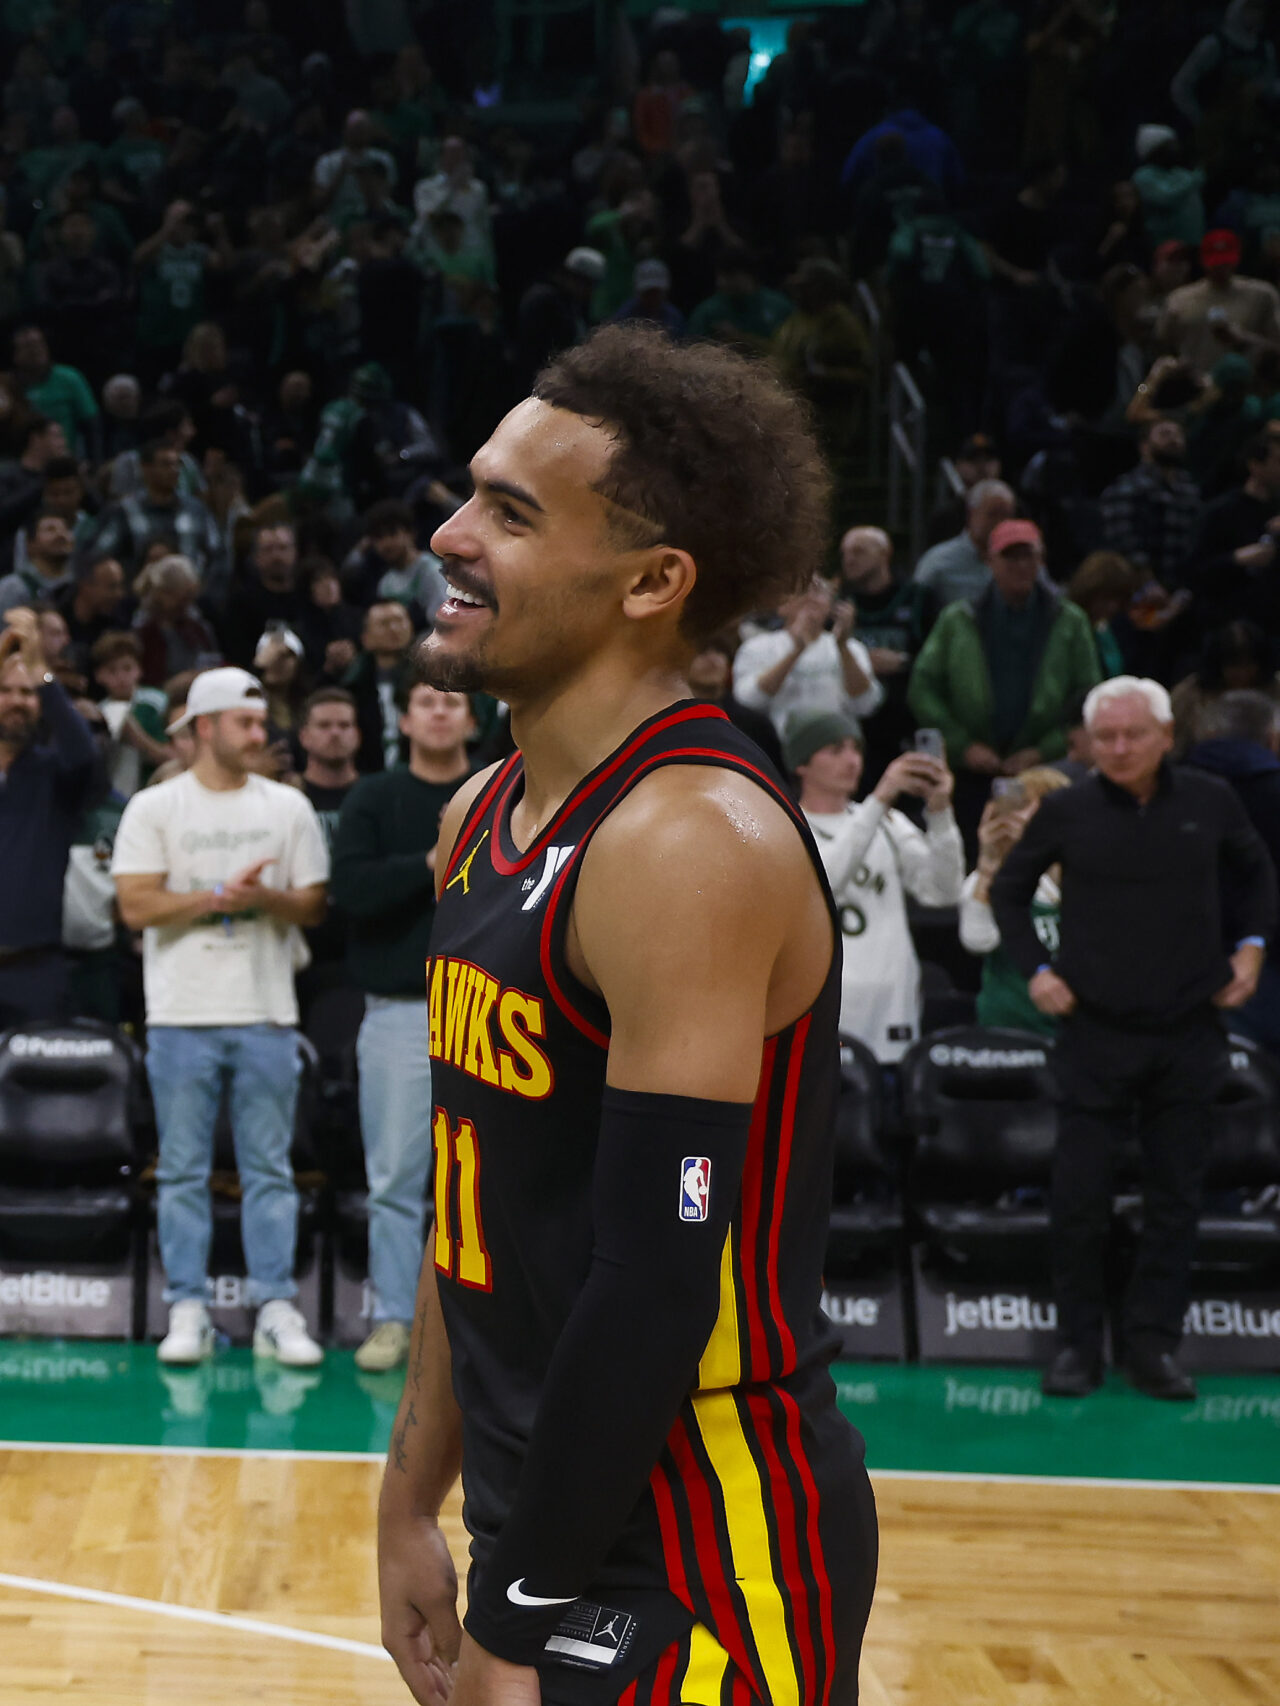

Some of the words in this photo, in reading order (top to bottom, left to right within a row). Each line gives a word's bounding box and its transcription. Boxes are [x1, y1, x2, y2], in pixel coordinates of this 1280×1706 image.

[426, 954, 554, 1101] AWKS
[431, 1104, 493, 1294] 11
[683, 1206, 698, 1218] NBA
[944, 1292, 1059, 1336] jetBlu
